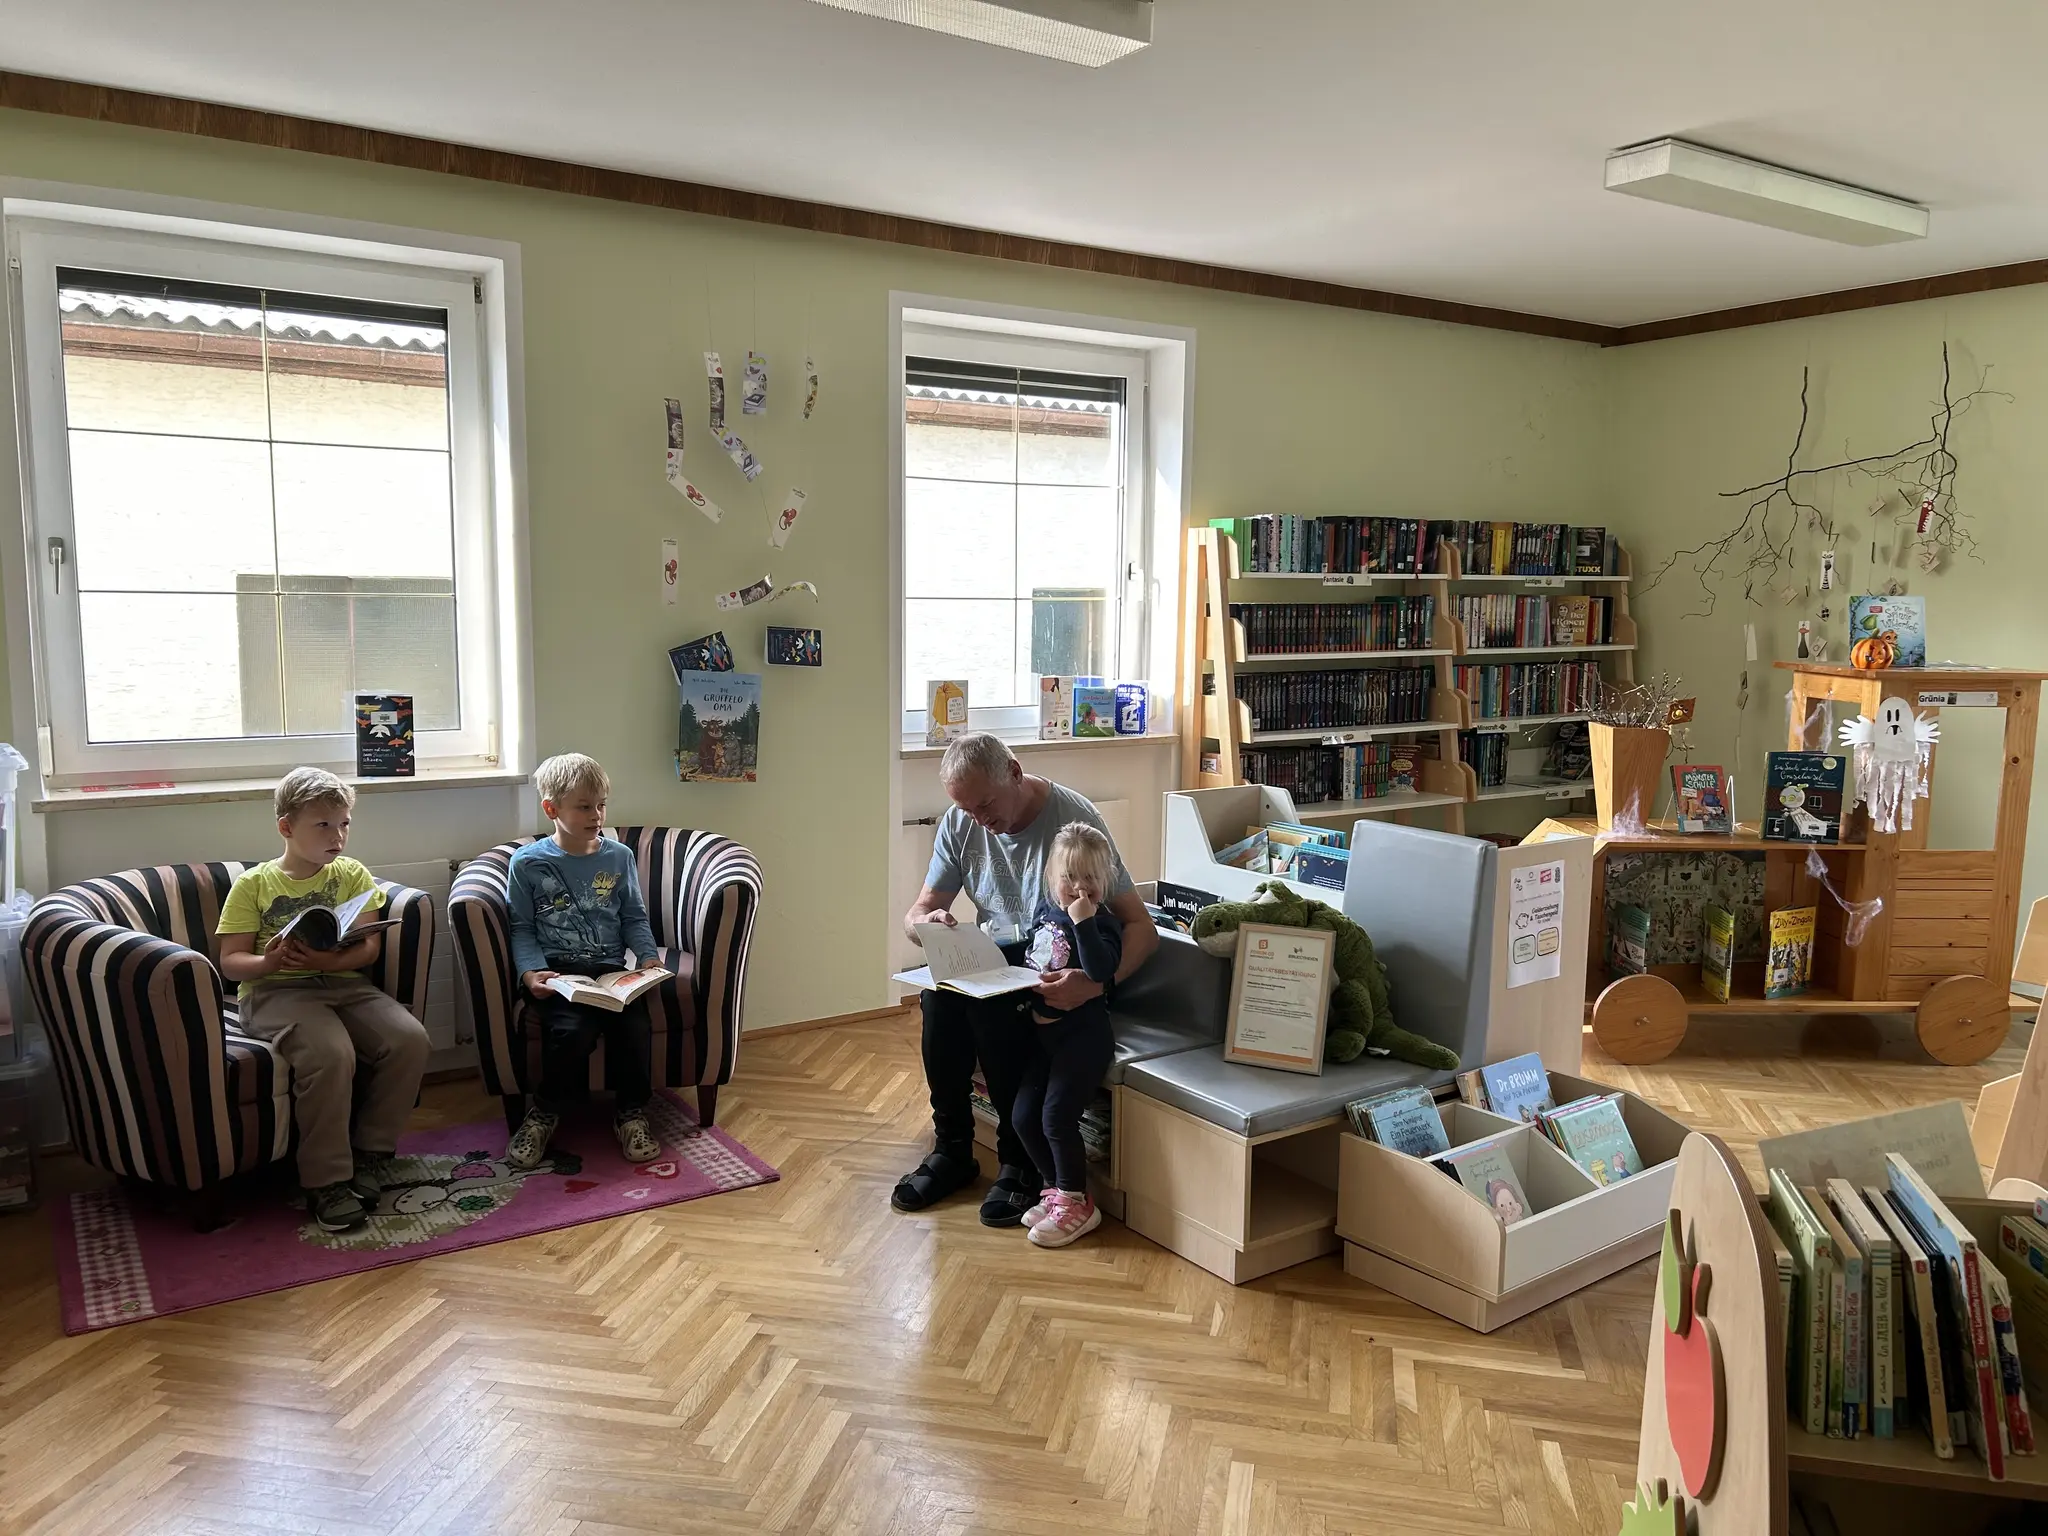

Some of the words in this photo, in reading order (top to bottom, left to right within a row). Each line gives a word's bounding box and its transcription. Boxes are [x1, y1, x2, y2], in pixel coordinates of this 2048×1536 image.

[1323, 575, 1345, 583] Fantasie
[1556, 617, 1585, 628] Rosen
[713, 703, 732, 711] OMA
[1477, 723, 1498, 731] Minecraft
[1686, 780, 1716, 790] SCHULE
[962, 853, 1044, 878] ORIGINA
[974, 891, 1034, 917] RIGINA
[1162, 894, 1176, 908] Jim
[1177, 900, 1198, 914] macht
[1496, 1078, 1511, 1093] Dr.
[1508, 1069, 1540, 1089] BRUMM
[1390, 1130, 1402, 1140] Ein
[1400, 1120, 1433, 1137] Feuerwerk
[1875, 1276, 1888, 1299] Wald
[1876, 1314, 1888, 1342] JAHR
[1976, 1330, 1985, 1346] Mein
